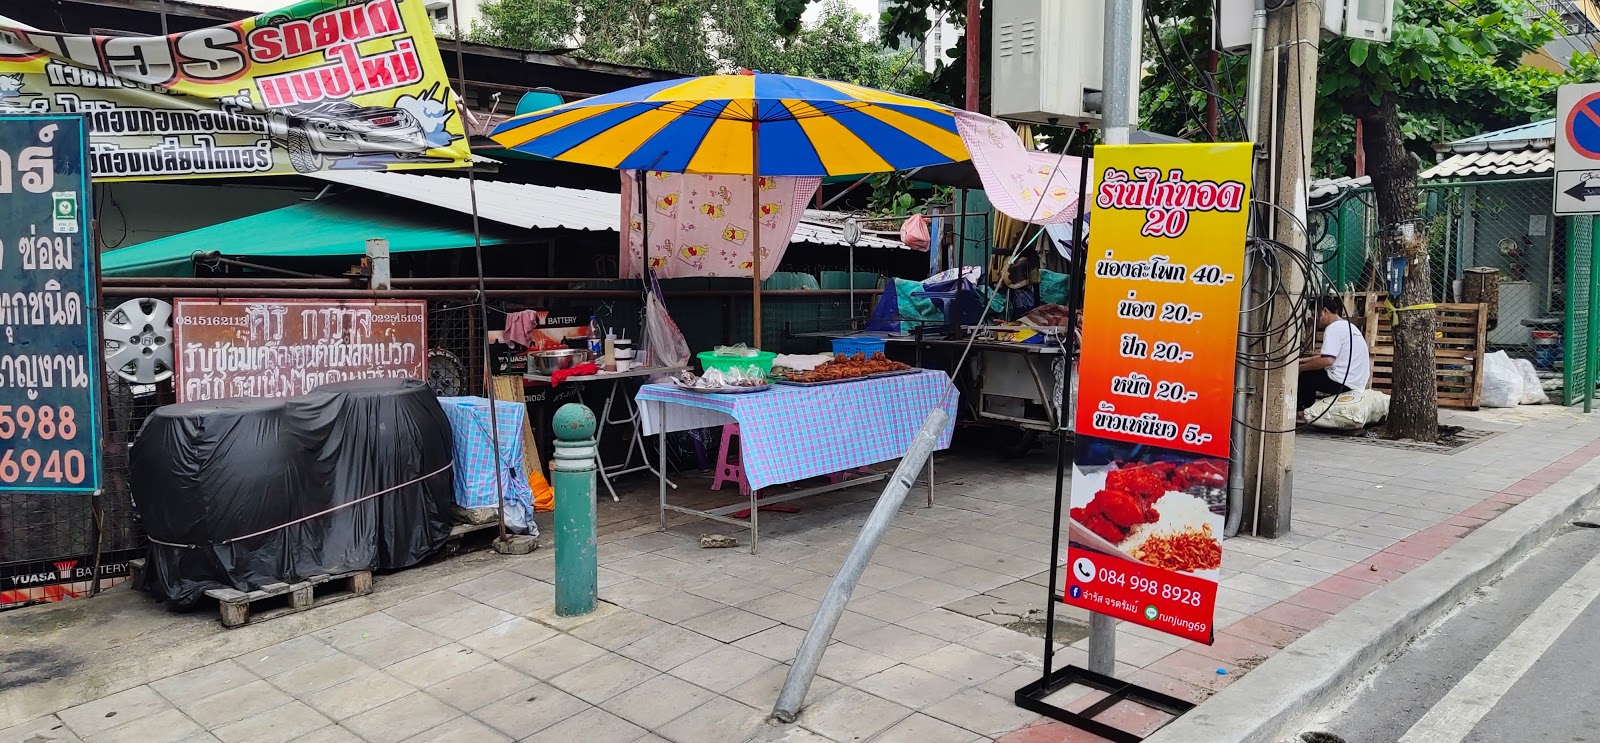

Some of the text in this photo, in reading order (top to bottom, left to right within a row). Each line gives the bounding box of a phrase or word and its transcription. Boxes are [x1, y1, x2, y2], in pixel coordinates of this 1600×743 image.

[1098, 168, 1244, 211] ร้านไก่ทอด
[1143, 208, 1189, 237] 20
[18, 224, 73, 270] ซ่อม
[1097, 251, 1233, 284] น่องสะโพก 40.-
[547, 316, 577, 326] BATTERY
[1119, 292, 1202, 322] น่อง 20.-
[1122, 335, 1192, 361] ปีก 20.-
[0, 355, 88, 400] าญงาน
[1113, 373, 1197, 401] หนัง 20.-
[0, 405, 77, 440] 5988
[1095, 402, 1212, 443] ข้าวเหนียว 5.-
[0, 449, 86, 484] 6940
[11, 571, 57, 585] YUASA
[1098, 567, 1201, 607] 084 998 8928
[1158, 613, 1206, 632] runjung69
